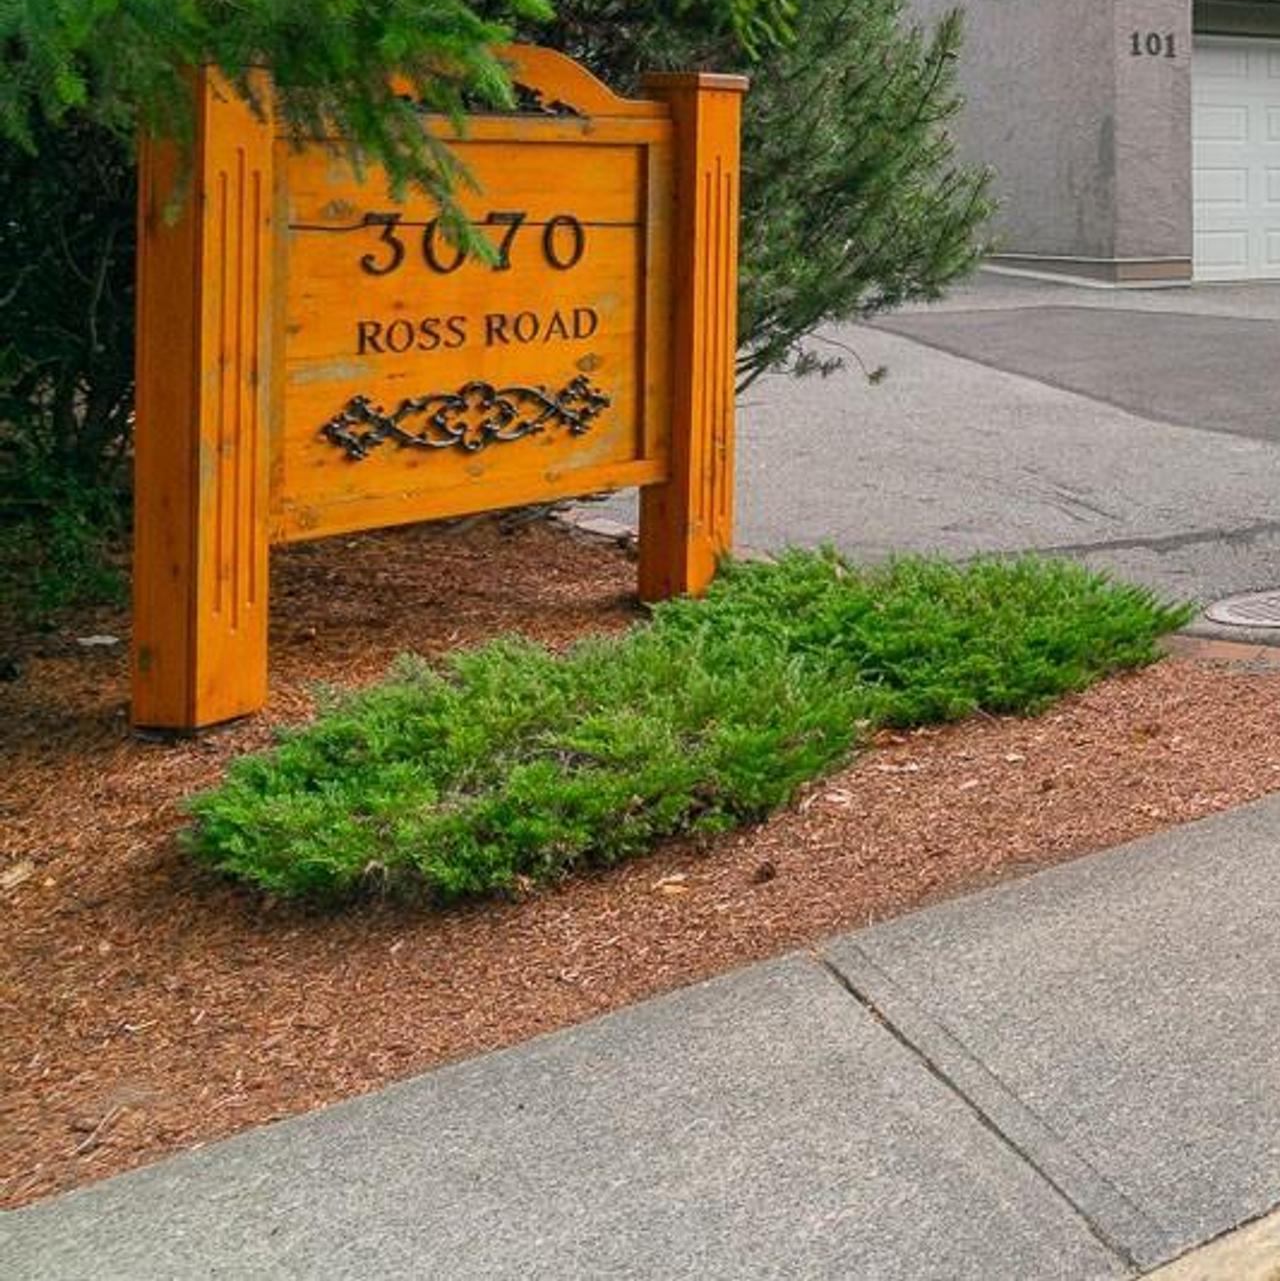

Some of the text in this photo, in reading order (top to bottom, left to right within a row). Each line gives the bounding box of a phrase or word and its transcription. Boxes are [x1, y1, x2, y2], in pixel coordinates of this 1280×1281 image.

[1128, 30, 1177, 59] 101
[360, 212, 585, 277] 3070
[356, 308, 599, 356] ROSS ROAD
